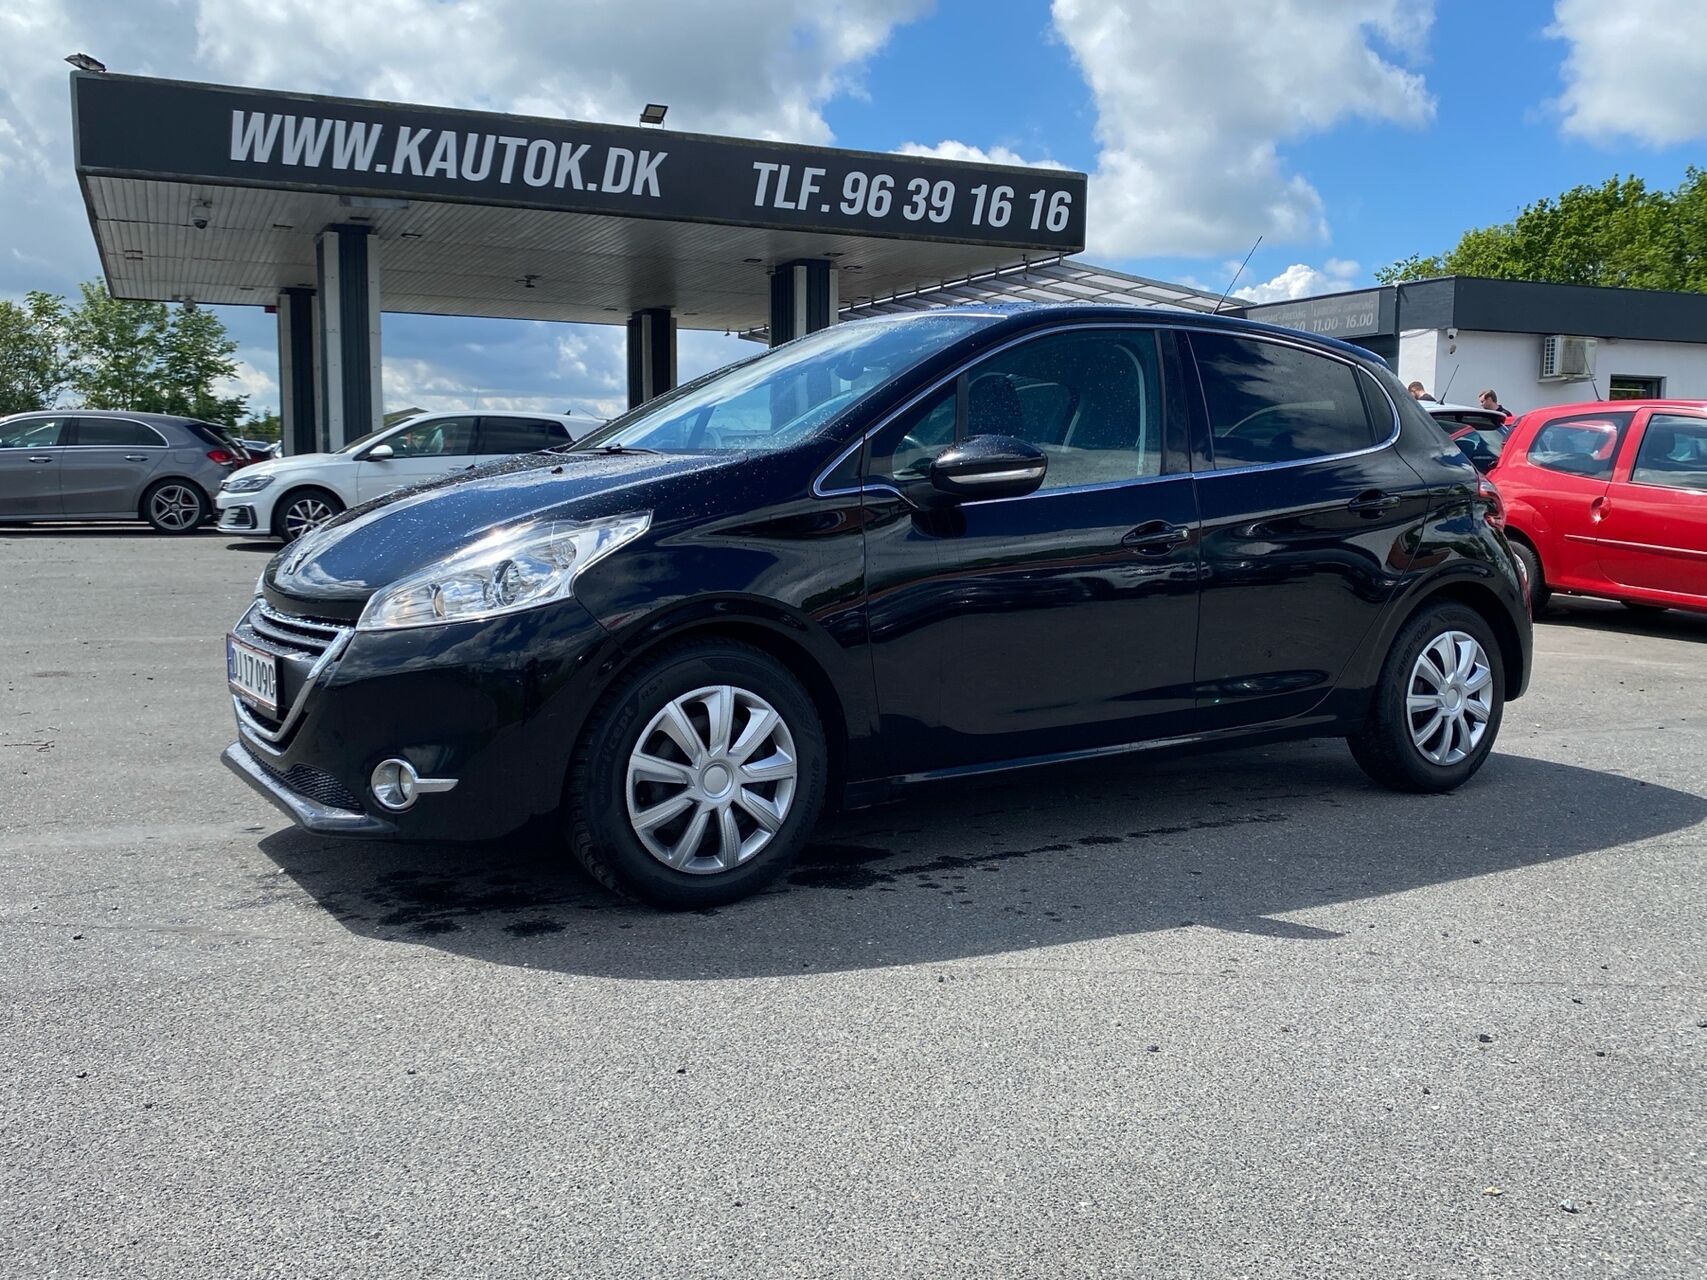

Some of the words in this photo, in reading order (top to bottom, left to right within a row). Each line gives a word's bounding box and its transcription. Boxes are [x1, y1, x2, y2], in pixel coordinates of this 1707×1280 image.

[230, 109, 668, 198] WWW.KAUTOK.DK
[752, 161, 830, 213] TLF.
[839, 170, 895, 218] 96
[902, 177, 956, 223] 39
[969, 183, 1015, 229] 16
[1028, 189, 1073, 233] 16
[1312, 317, 1339, 332] 11.00
[1345, 313, 1374, 329] 16.00
